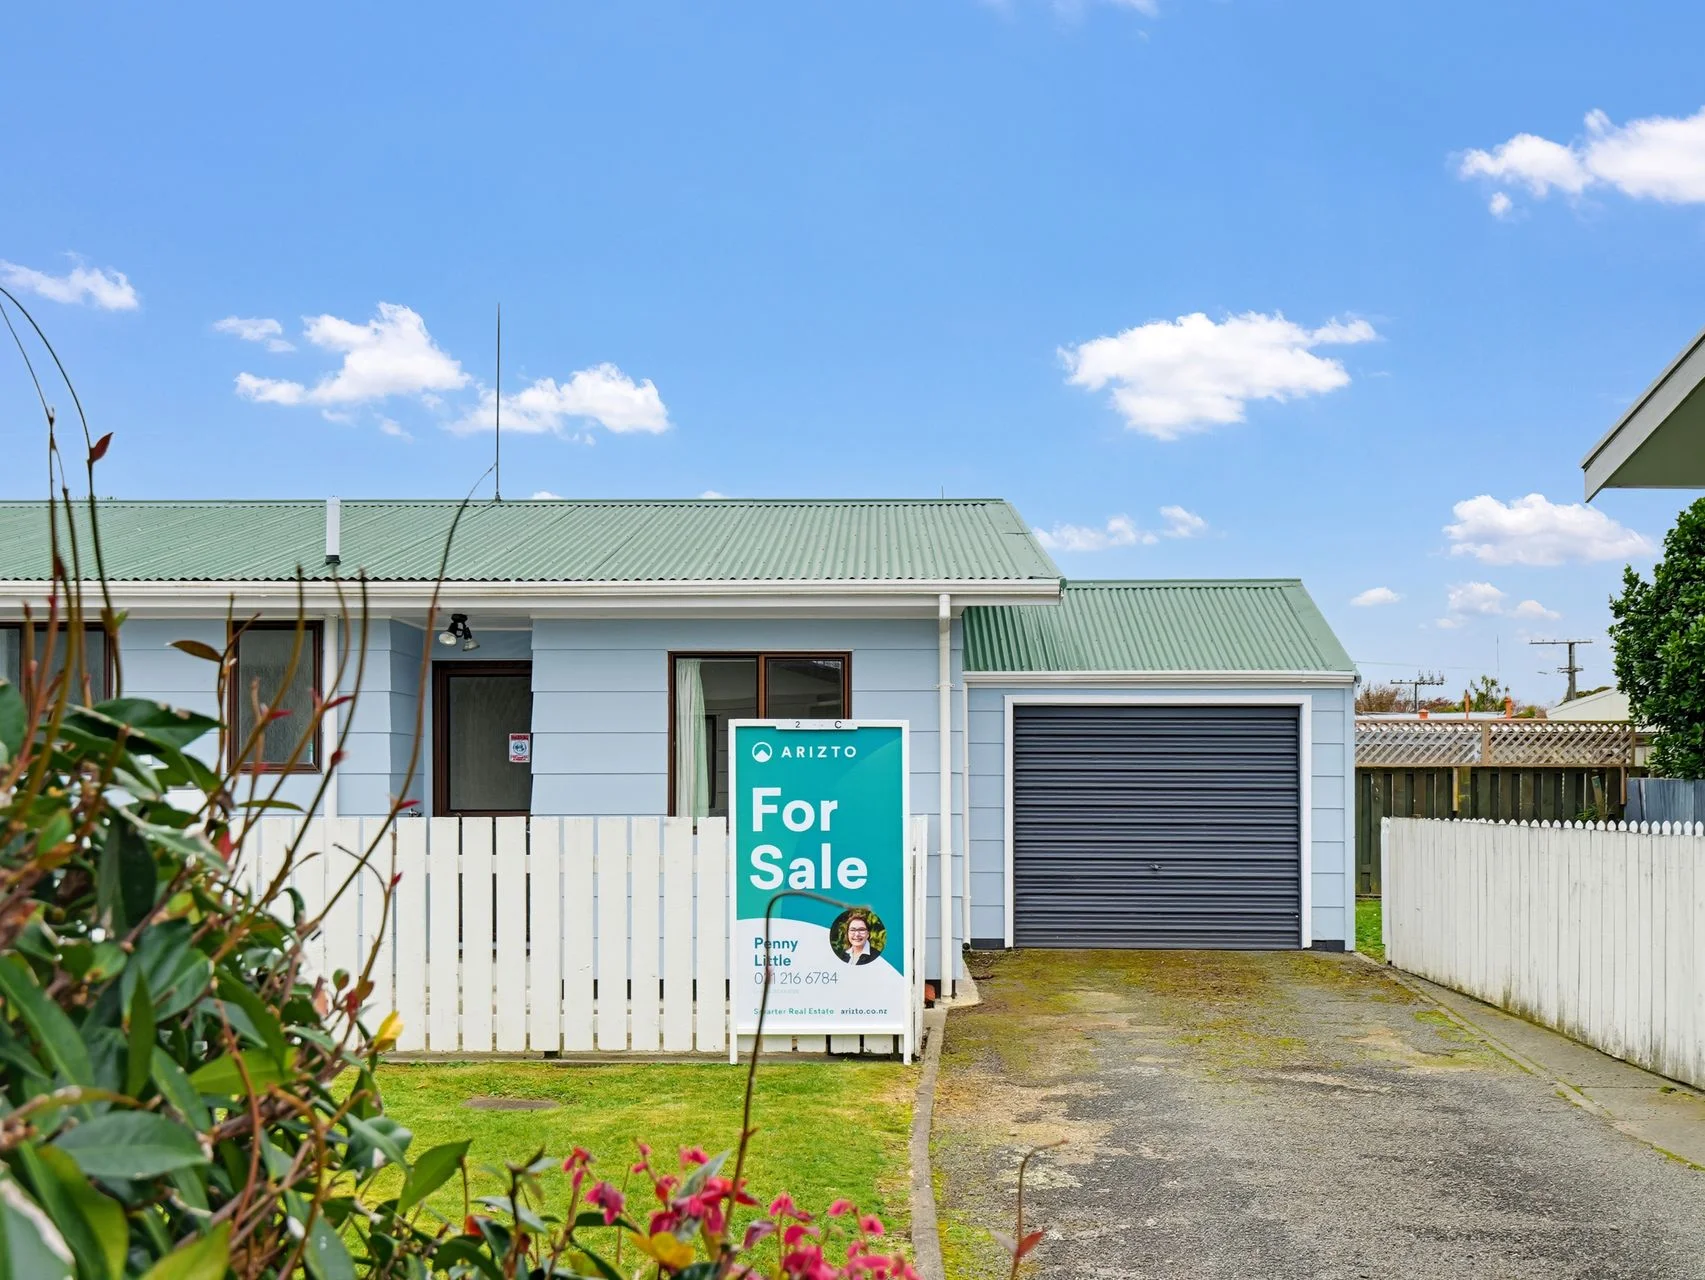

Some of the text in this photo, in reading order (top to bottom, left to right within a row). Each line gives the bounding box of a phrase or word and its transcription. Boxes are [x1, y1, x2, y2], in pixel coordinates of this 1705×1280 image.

[795, 720, 842, 729] 2 C
[781, 745, 857, 758] ARIZTO
[752, 787, 838, 832] For
[749, 843, 868, 890] Sale
[754, 937, 798, 952] Penny
[754, 972, 838, 985] 01 216 6784
[788, 1007, 807, 1015] Real
[808, 1007, 834, 1015] Estate
[840, 1007, 888, 1015] arizto.co.nz
